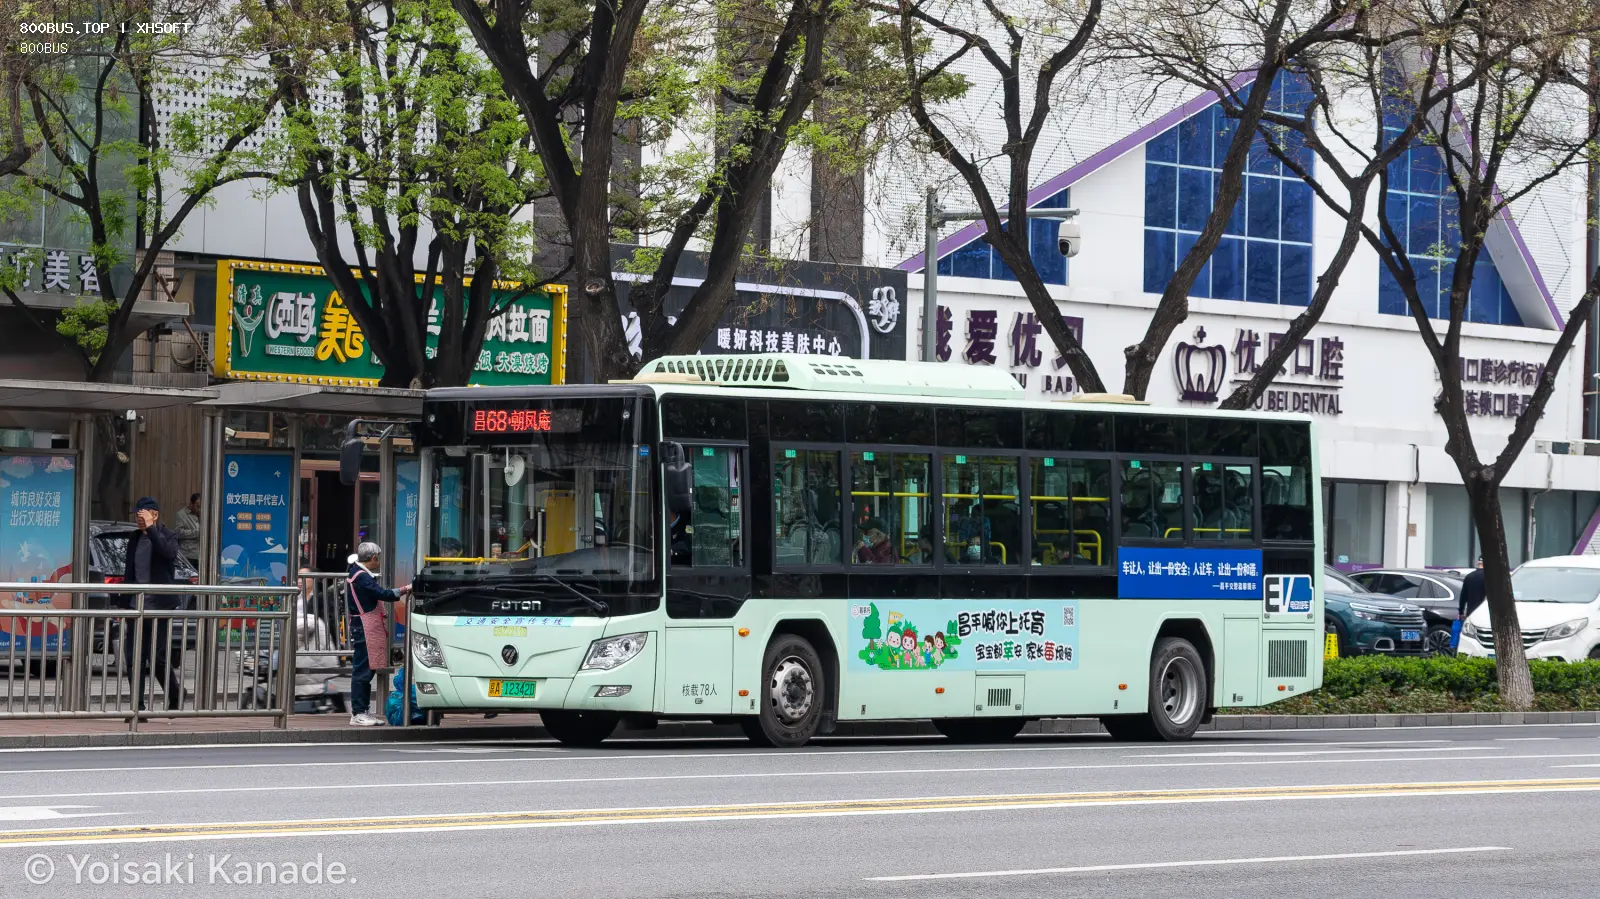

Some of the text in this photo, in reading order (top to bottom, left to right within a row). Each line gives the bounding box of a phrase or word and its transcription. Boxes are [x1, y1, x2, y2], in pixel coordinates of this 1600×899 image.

[266, 345, 314, 357] WESTERN FOODS
[717, 327, 842, 356] 暖妍科技美肤中心
[496, 351, 549, 374] 大漠烧烤
[1264, 390, 1288, 411] BEI
[1289, 390, 1343, 414] DENTAL
[11, 490, 61, 507] 城市良好交通
[226, 493, 285, 506] 做文明昌平代言人
[10, 509, 61, 527] 出行文明相伴
[492, 600, 541, 611] FOTON
[958, 609, 1046, 638] 昌平喊你上托育
[975, 640, 1023, 661] 宝宝都苹安
